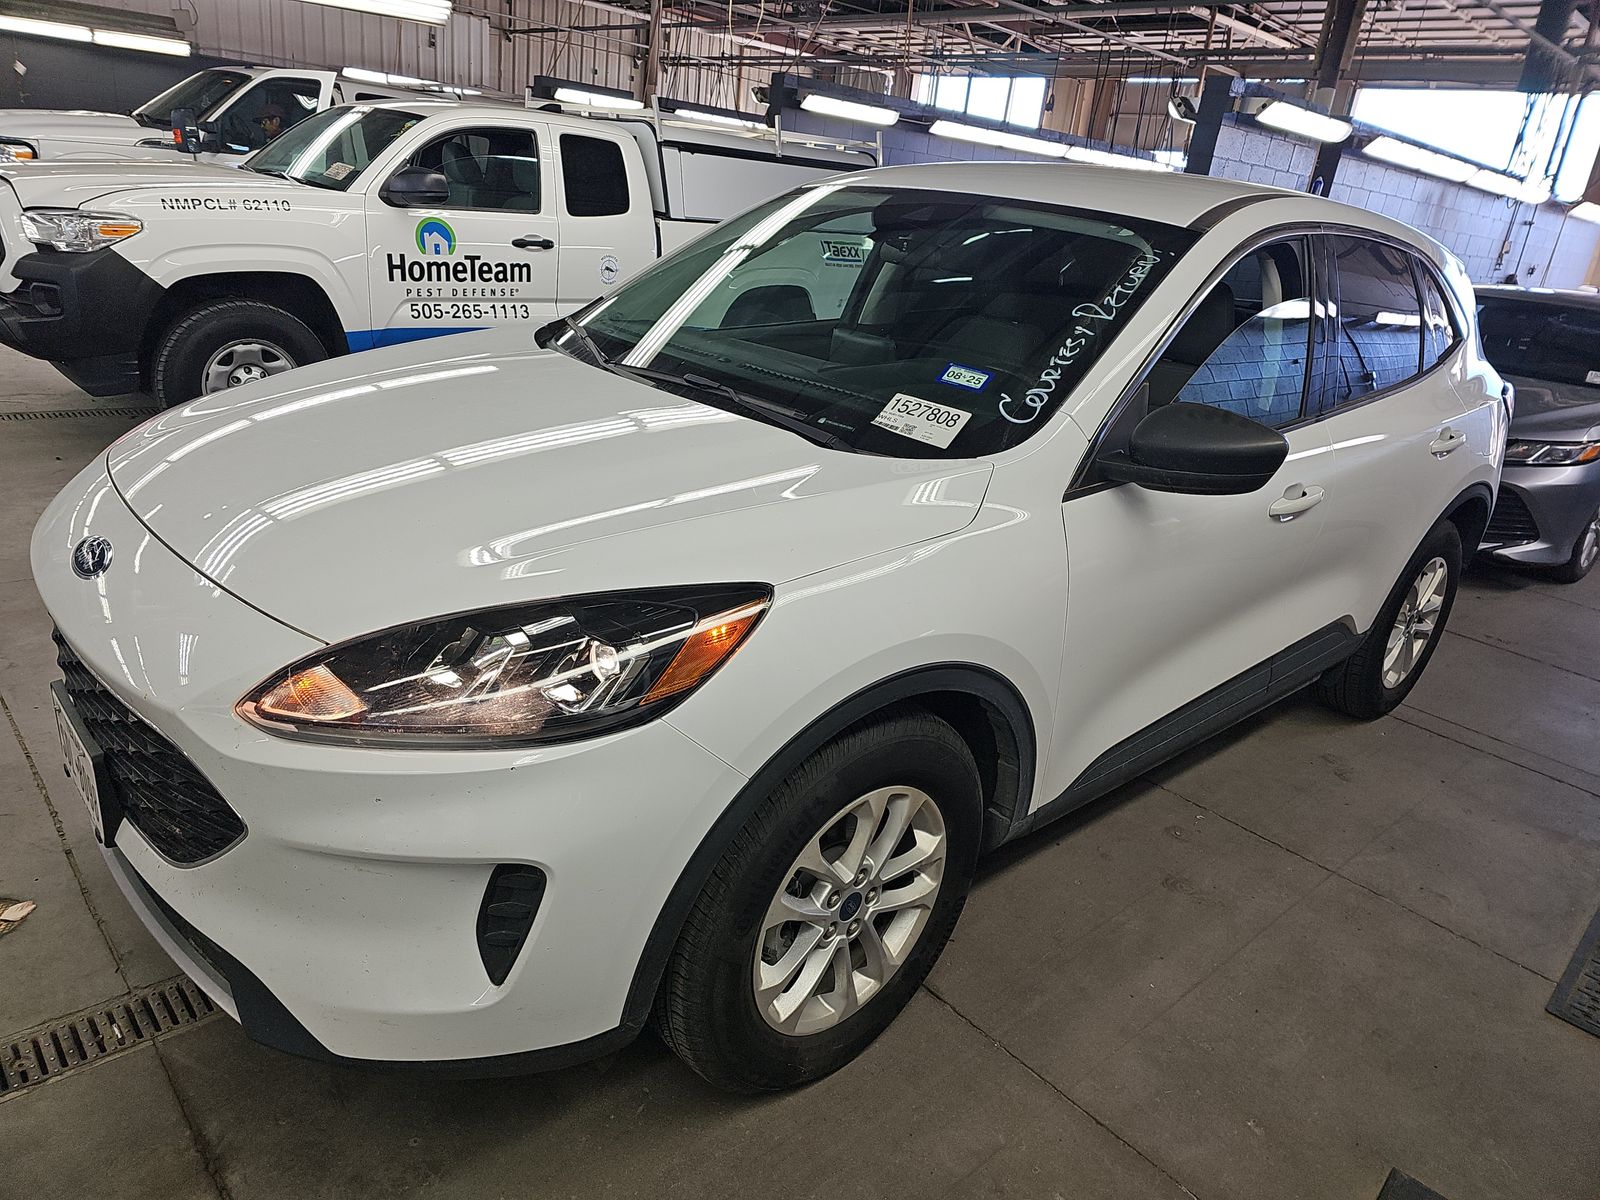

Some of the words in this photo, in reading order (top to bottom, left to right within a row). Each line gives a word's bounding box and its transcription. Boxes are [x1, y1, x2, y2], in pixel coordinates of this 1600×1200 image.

[160, 198, 237, 210] NMPCL#
[242, 199, 291, 211] 62110
[386, 253, 532, 283] HomeTeam
[406, 288, 443, 297] PEST
[410, 303, 530, 319] 505-265-1113
[890, 397, 961, 428] 1527808
